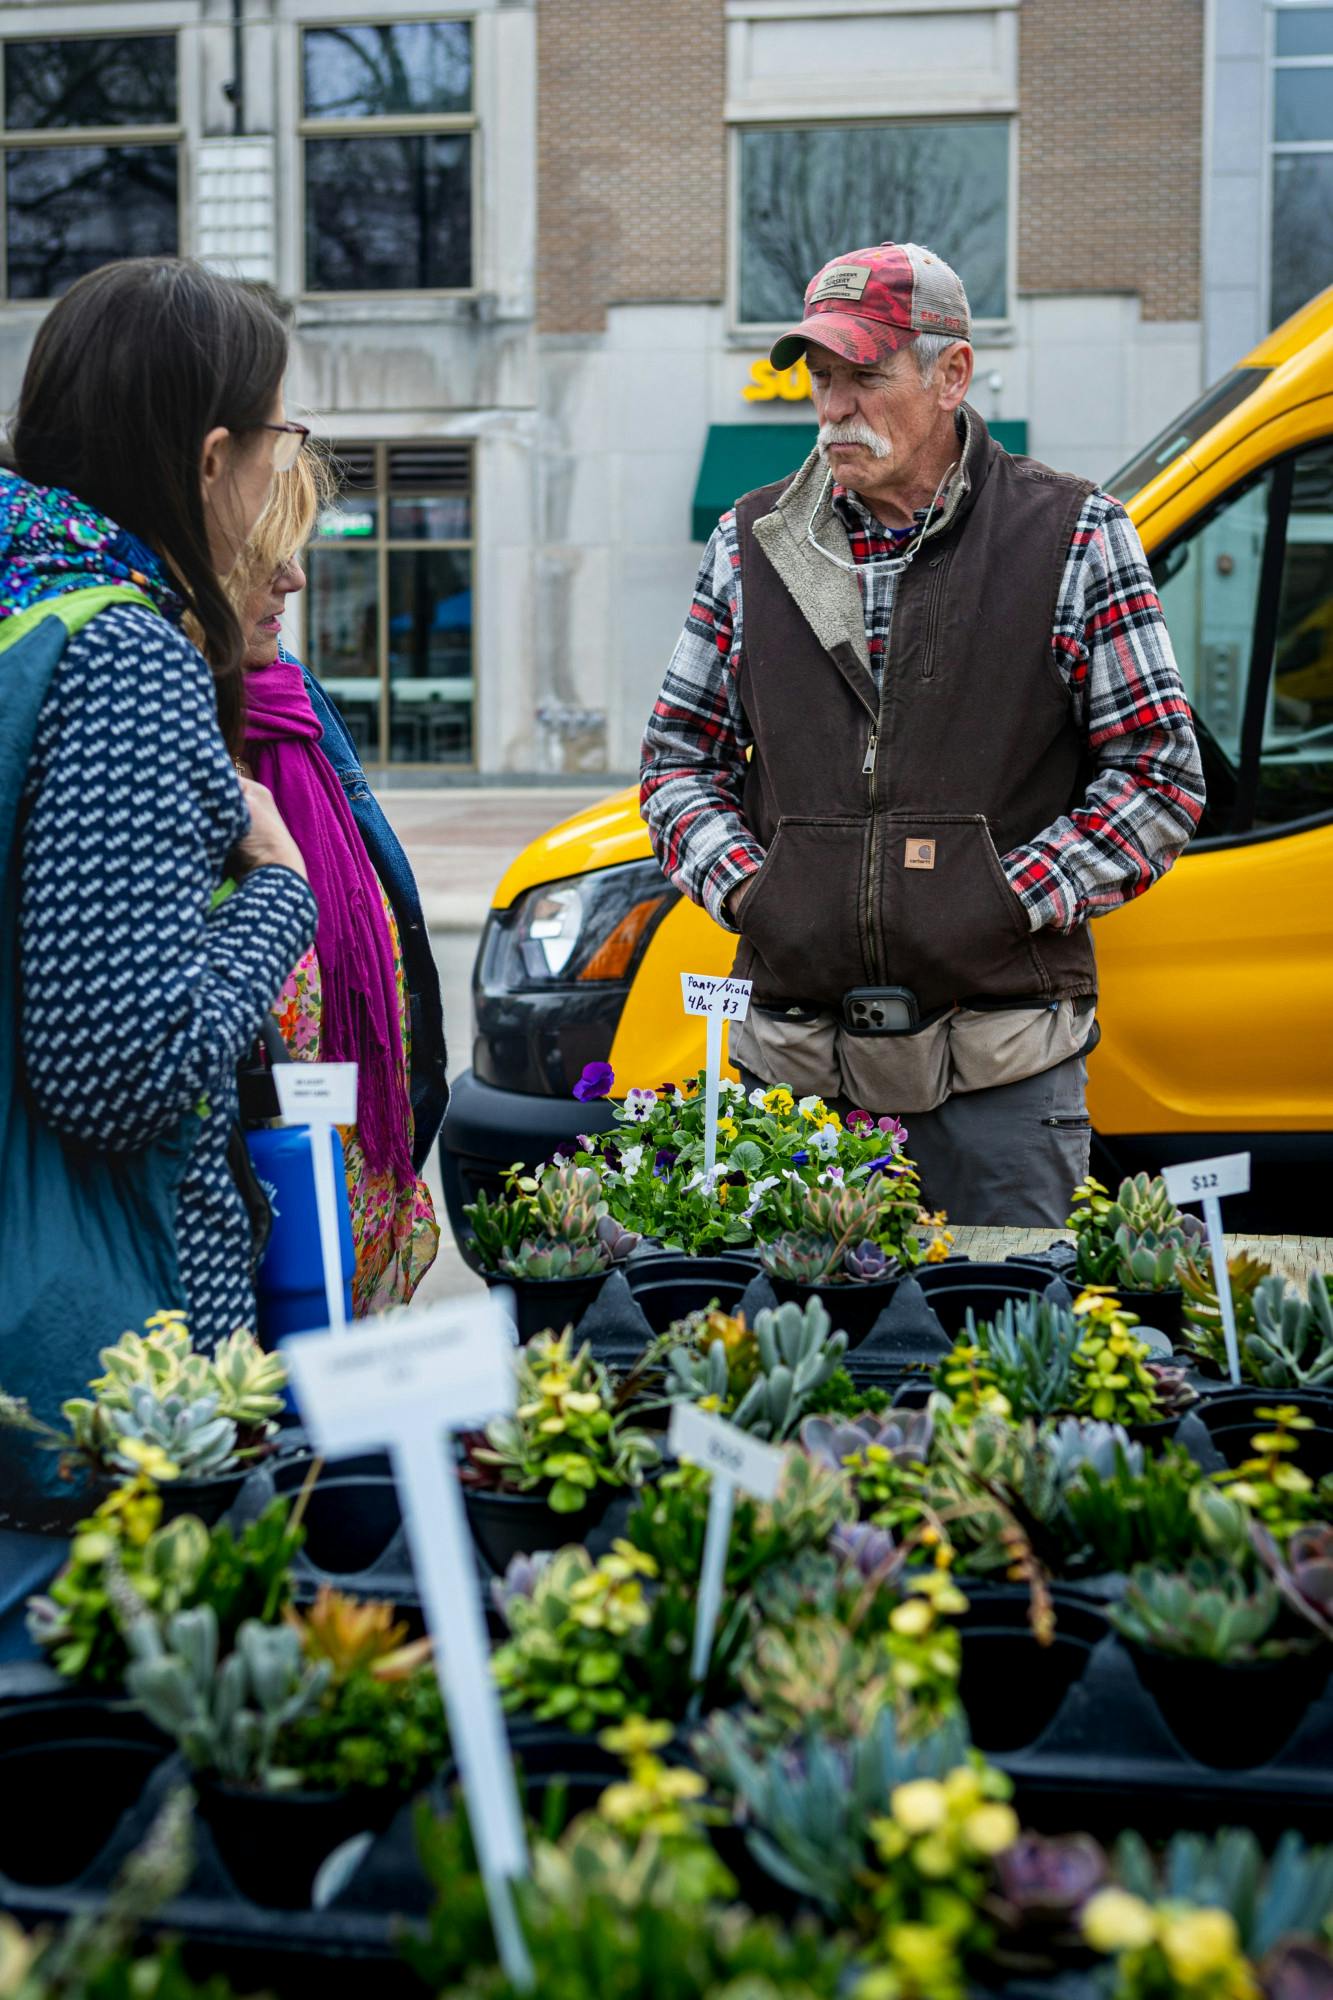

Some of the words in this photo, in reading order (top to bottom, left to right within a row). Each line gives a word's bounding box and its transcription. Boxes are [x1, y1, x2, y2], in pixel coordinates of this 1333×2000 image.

[742, 356, 812, 402] SU
[722, 998, 739, 1013] $3
[1191, 1173, 1218, 1192] $12
